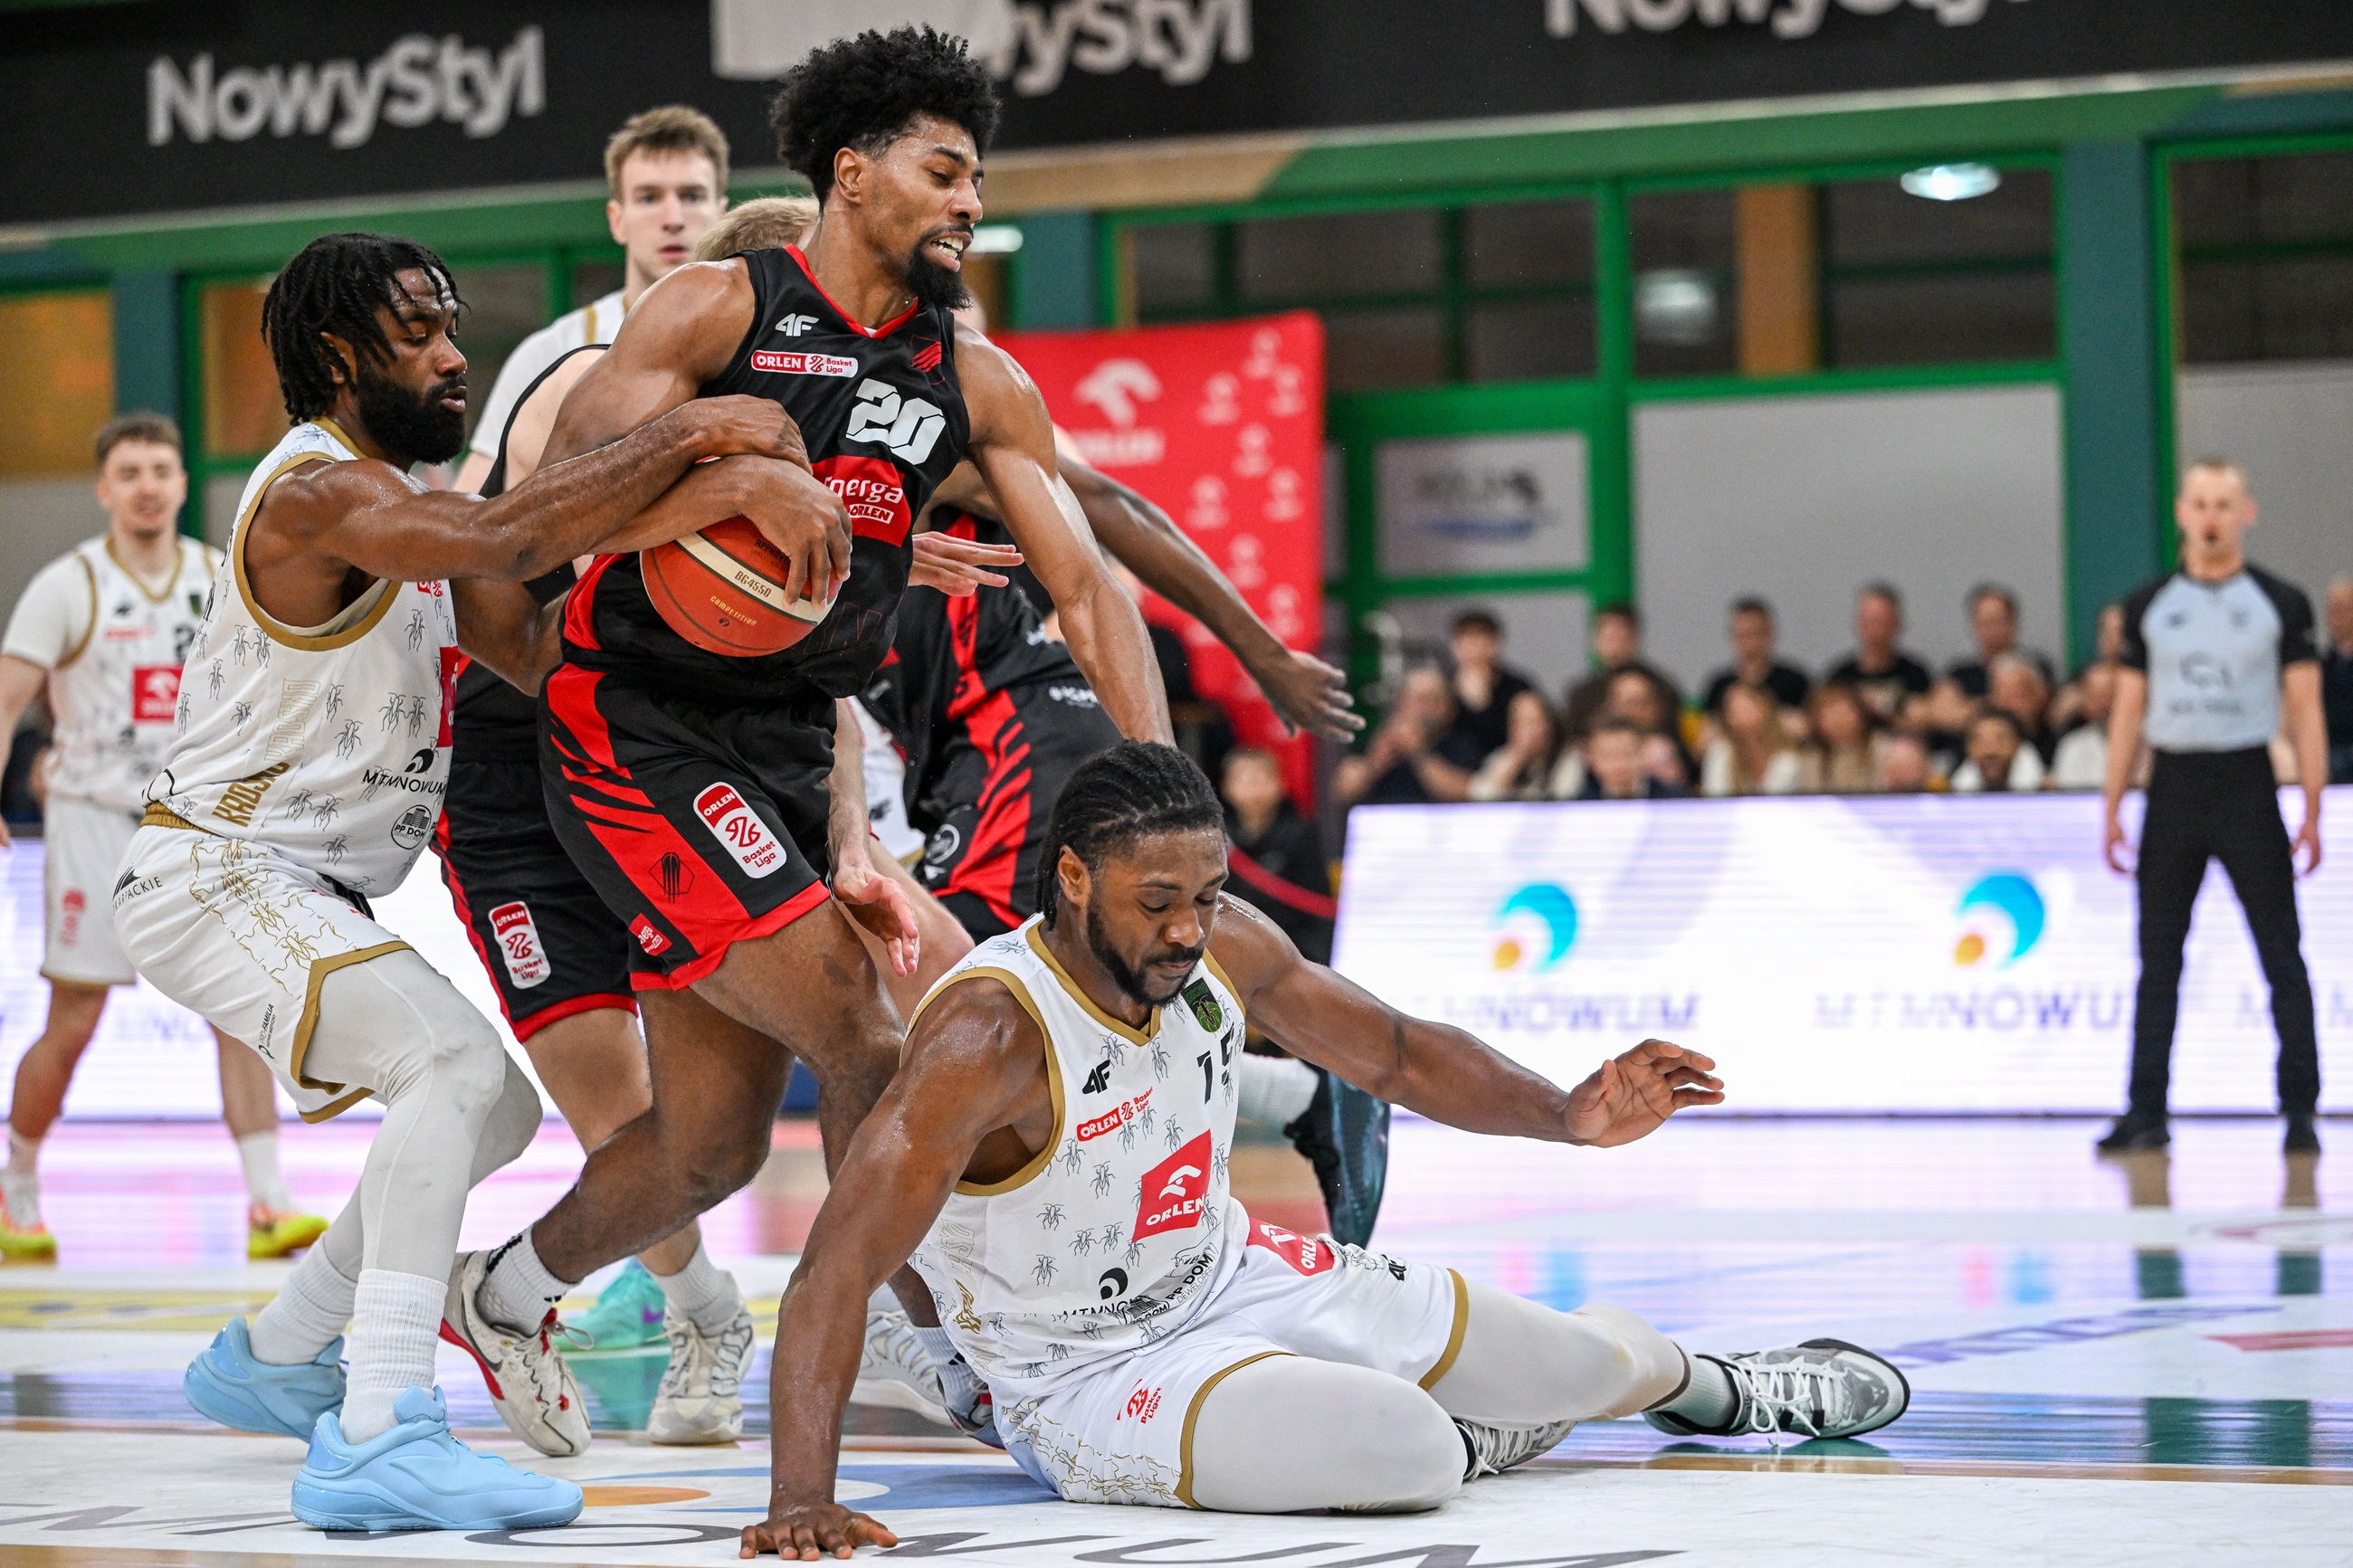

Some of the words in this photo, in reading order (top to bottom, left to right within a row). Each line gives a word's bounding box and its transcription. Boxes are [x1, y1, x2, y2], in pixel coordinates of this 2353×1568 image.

[148, 25, 546, 147] NowyStyl
[776, 313, 819, 337] 4F
[756, 355, 802, 369] ORLEN
[826, 358, 853, 366] Basket
[826, 366, 843, 374] Liga
[846, 378, 946, 465] 20
[850, 505, 890, 523] ORLEN
[755, 540, 791, 565] APPROVE
[735, 571, 771, 598] BG4550
[710, 595, 757, 626] COMPETITION
[703, 792, 735, 817] ORLEN
[394, 824, 406, 832] PP
[742, 841, 776, 864] Basket
[754, 852, 776, 868] Liga
[496, 910, 525, 927] ORLEN
[512, 957, 543, 974] Basket
[1081, 1059, 1110, 1095] 4F
[1081, 1113, 1119, 1137] ORLEN
[1146, 1193, 1205, 1226] ORLEN
[1300, 1235, 1317, 1269] ORLE
[1166, 1287, 1184, 1300] PP
[1182, 1253, 1214, 1285] DOM
[1176, 1267, 1214, 1304] DEWELOPER
[1148, 1395, 1161, 1419] Liga
